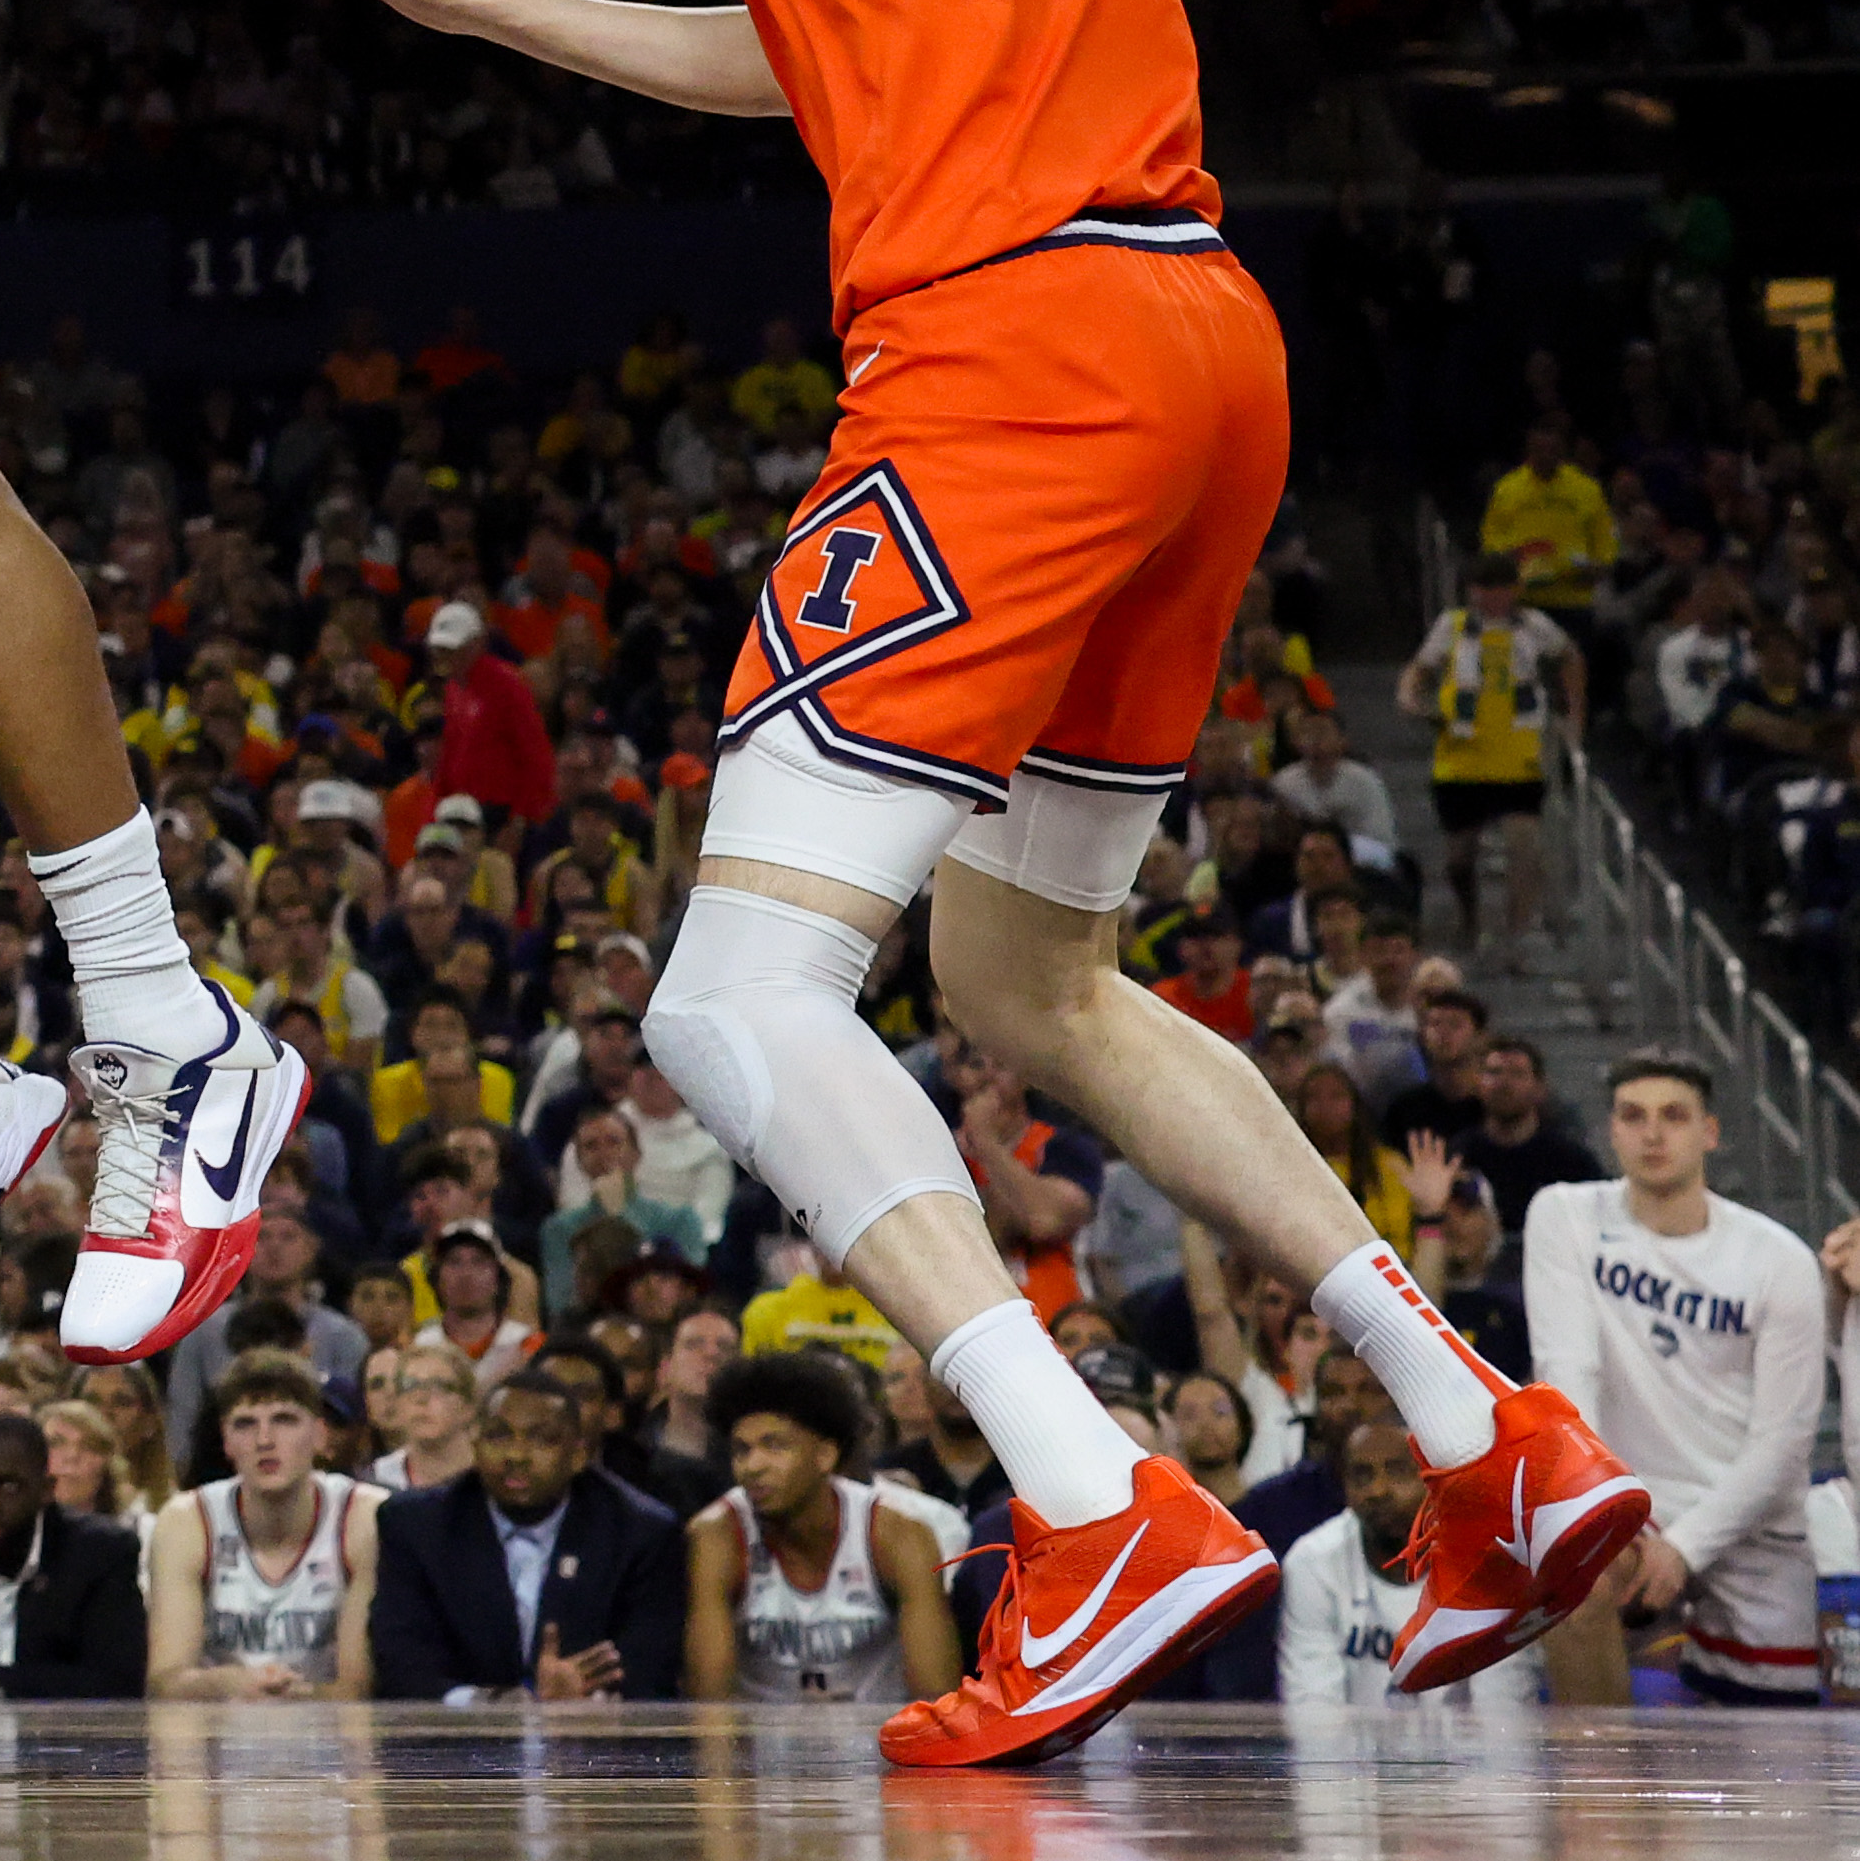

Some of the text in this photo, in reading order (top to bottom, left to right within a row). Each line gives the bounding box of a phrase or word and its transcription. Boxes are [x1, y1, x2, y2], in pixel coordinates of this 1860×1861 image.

[182, 233, 311, 299] 114
[1595, 1254, 1672, 1314] LOCK
[1674, 1291, 1704, 1325] IT
